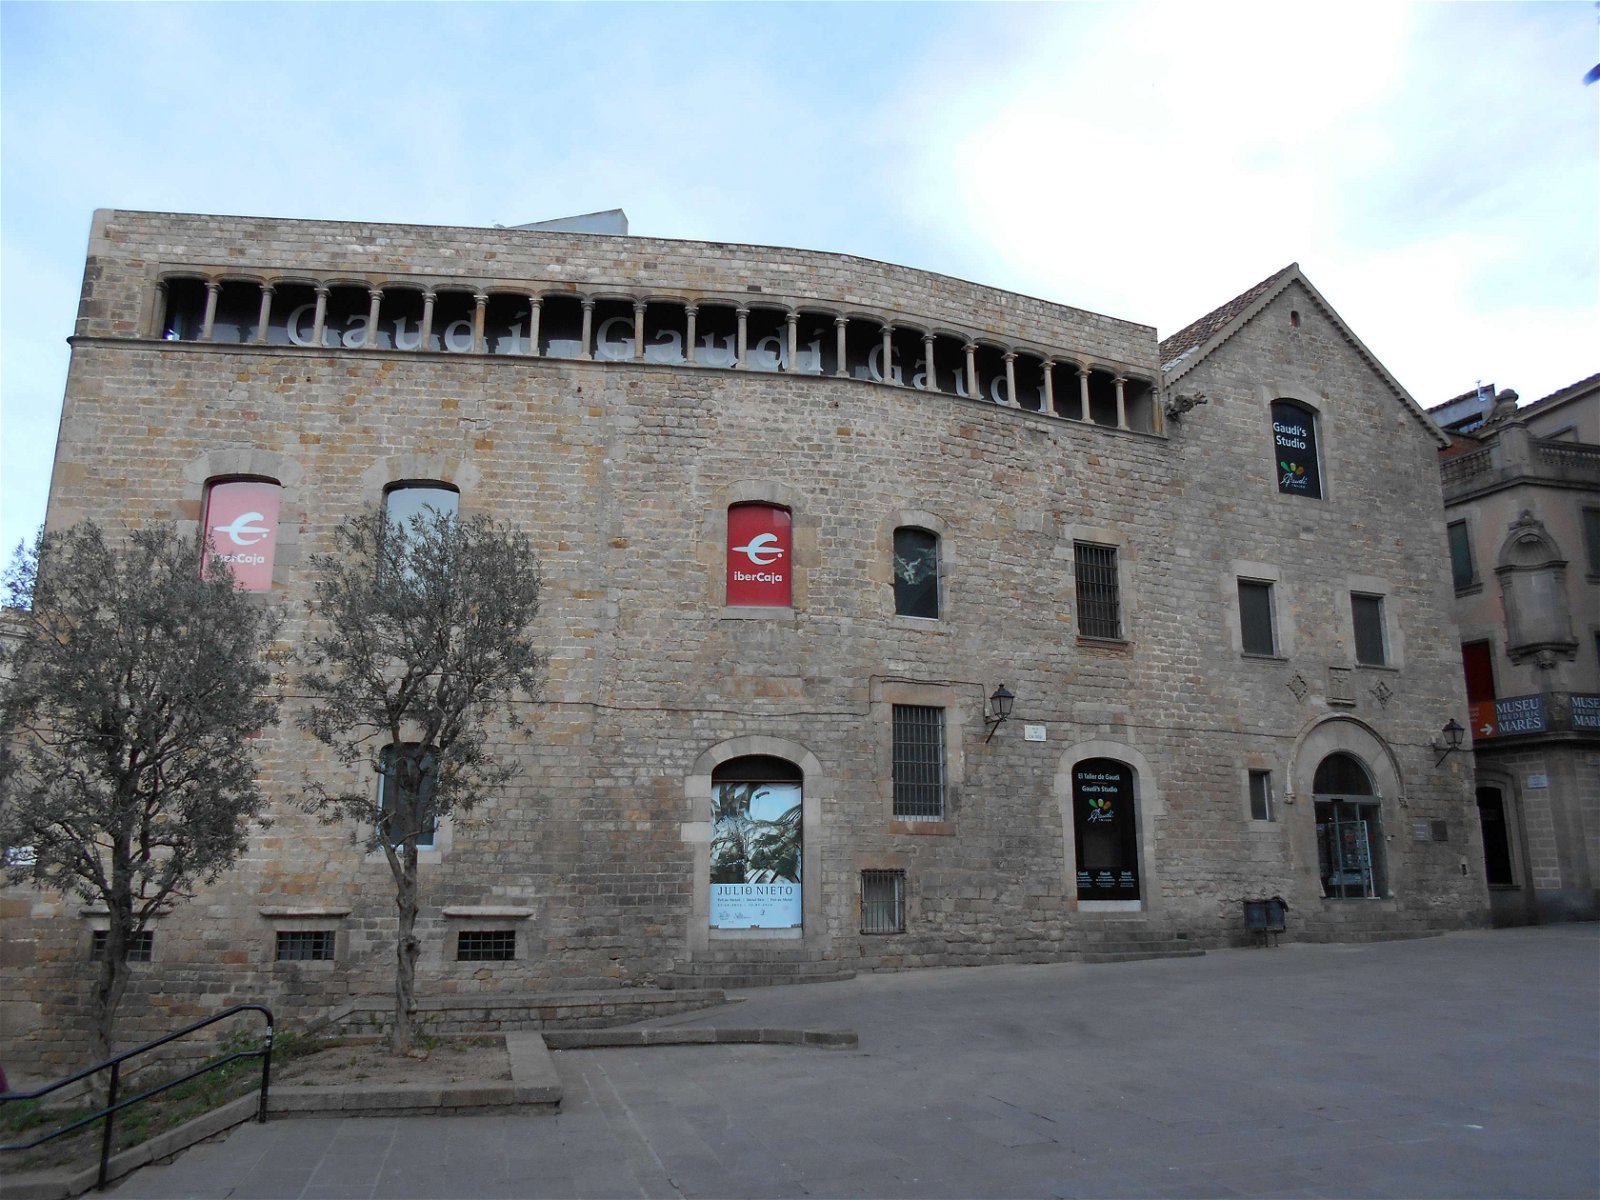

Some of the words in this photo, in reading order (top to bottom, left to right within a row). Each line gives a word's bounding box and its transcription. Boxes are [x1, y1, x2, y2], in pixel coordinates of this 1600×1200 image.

[596, 316, 825, 375] Gaudí
[1276, 435, 1306, 449] Studio
[733, 571, 783, 585] iberCaja
[1496, 698, 1539, 714] MUSEU
[717, 886, 753, 896] JULIO
[756, 885, 793, 896] NIETO
